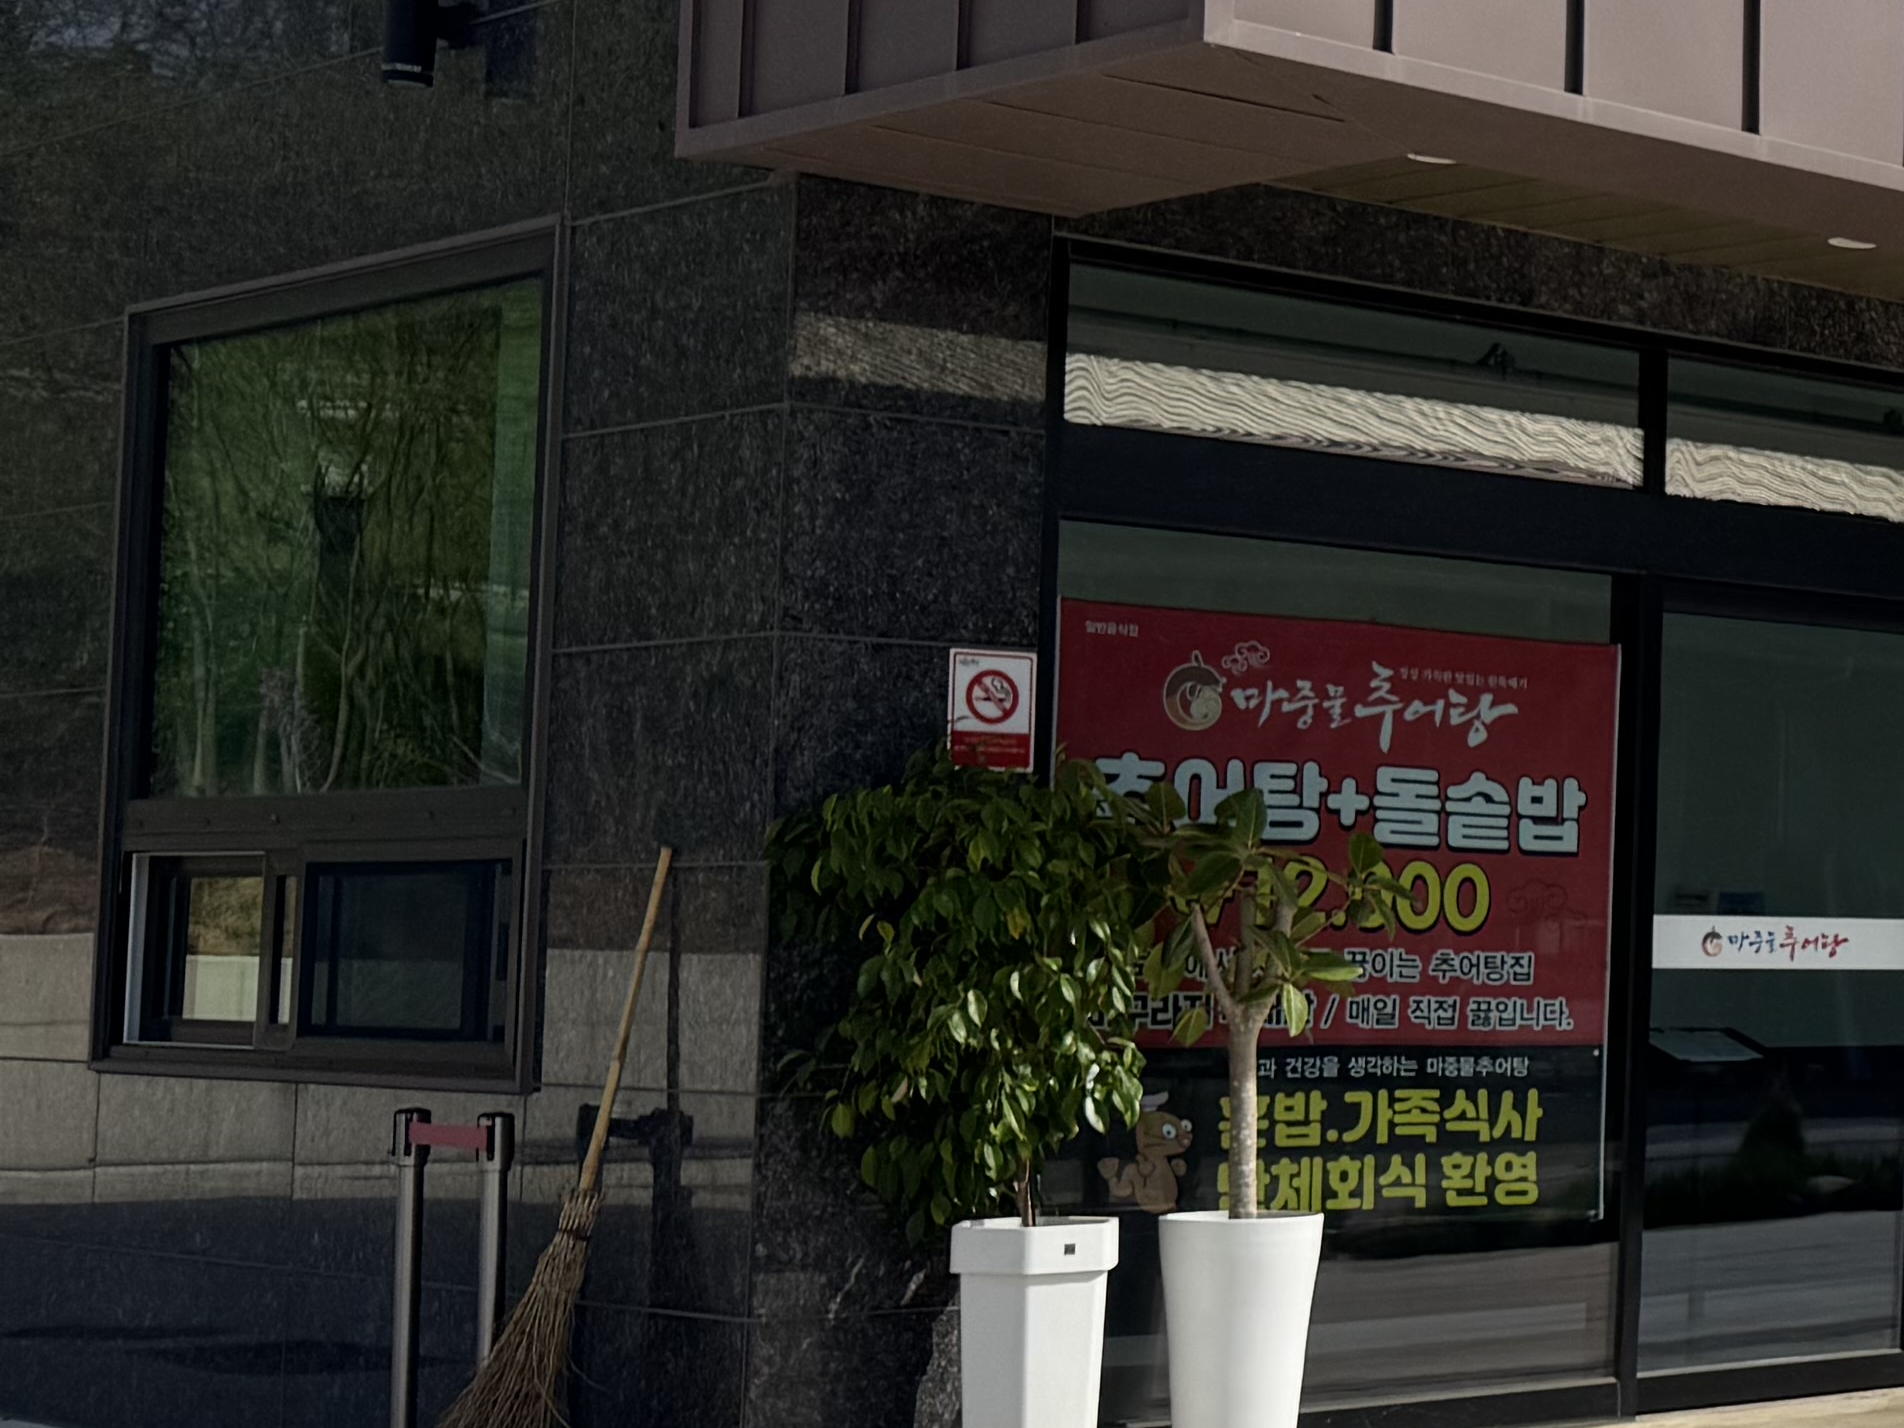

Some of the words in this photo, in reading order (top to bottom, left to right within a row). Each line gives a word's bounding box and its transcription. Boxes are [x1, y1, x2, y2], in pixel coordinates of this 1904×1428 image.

[1230, 679, 1352, 730] 마중물
[1354, 661, 1519, 754] 추어탕
[1779, 925, 1849, 961] 추어탕
[1431, 949, 1535, 985] 추어탕집
[1347, 994, 1400, 1028] 매일
[1409, 995, 1460, 1030] 직접
[1468, 996, 1574, 1032] 끓입니다.
[1285, 1055, 1341, 1079] 건강을
[1348, 1055, 1420, 1079] 생각하는
[1440, 1150, 1540, 1209] 환영
